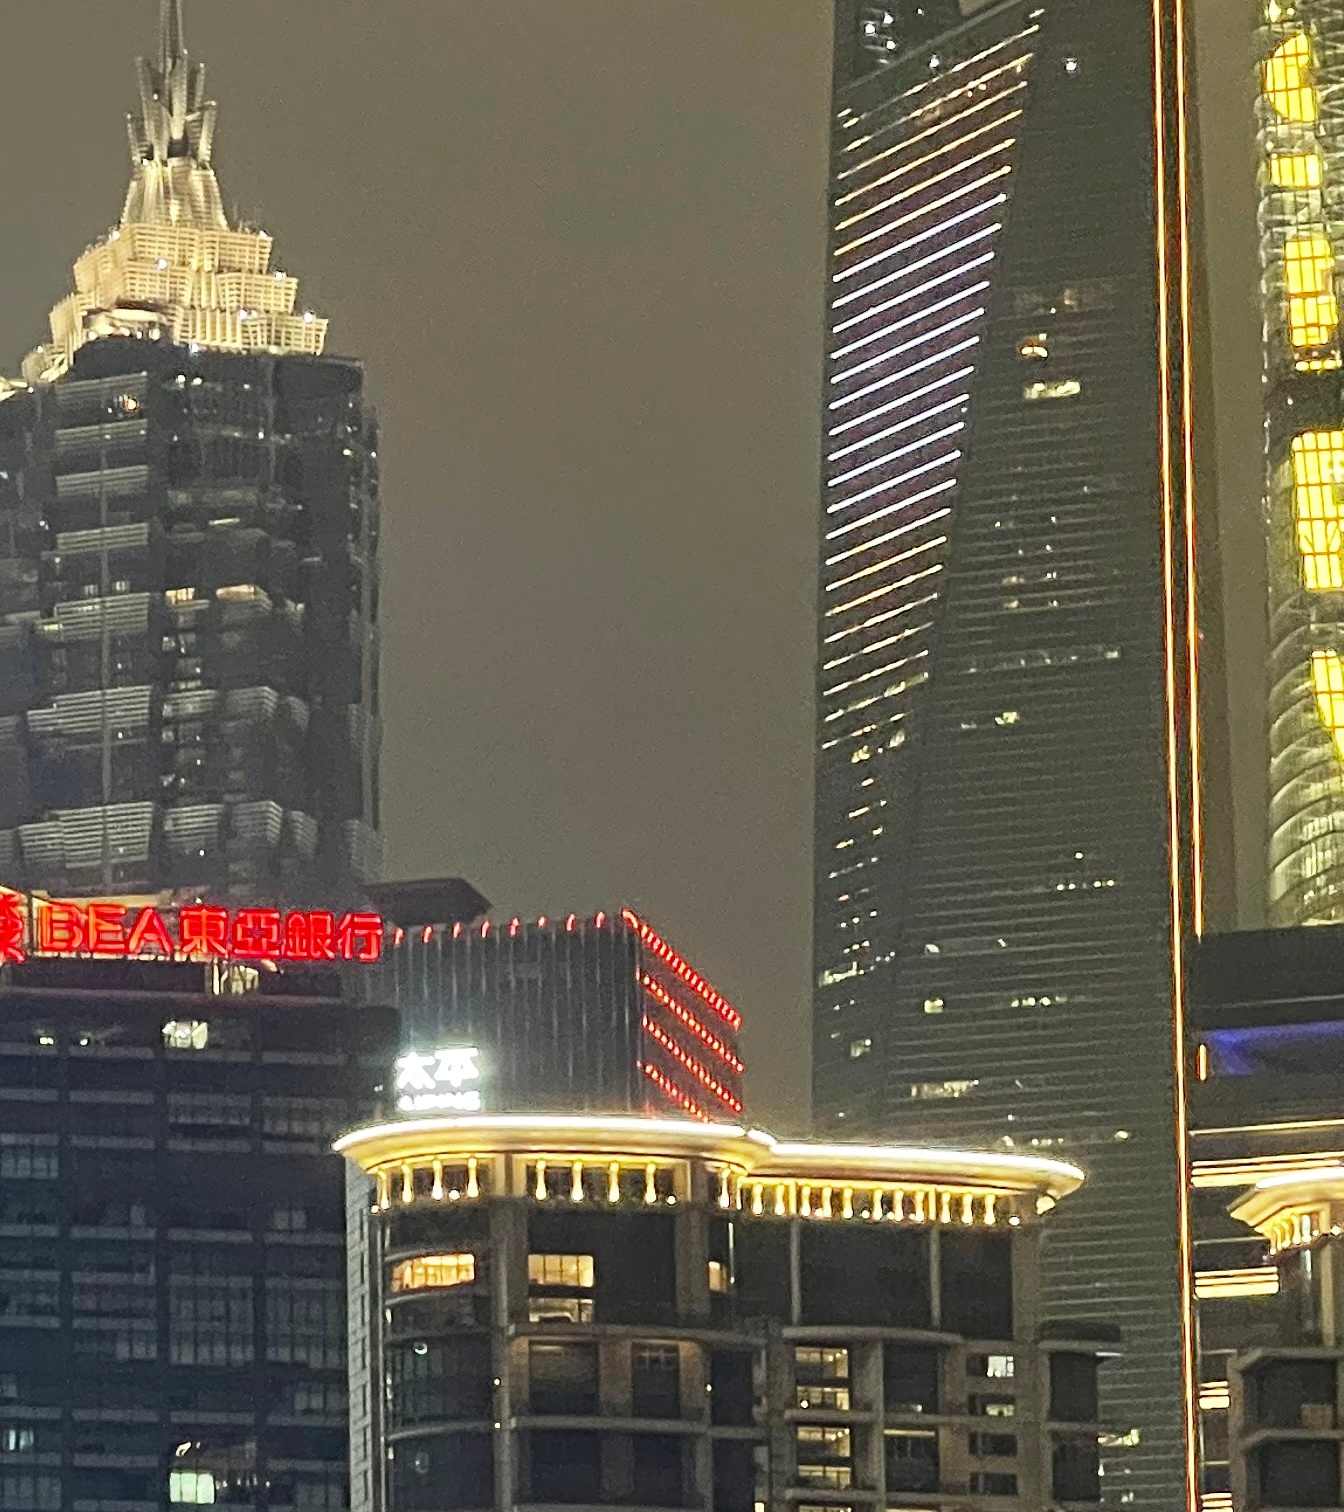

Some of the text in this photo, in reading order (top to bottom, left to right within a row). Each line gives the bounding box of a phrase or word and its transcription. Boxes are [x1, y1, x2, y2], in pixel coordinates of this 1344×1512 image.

[38, 903, 382, 962] BEA 東亞銀行
